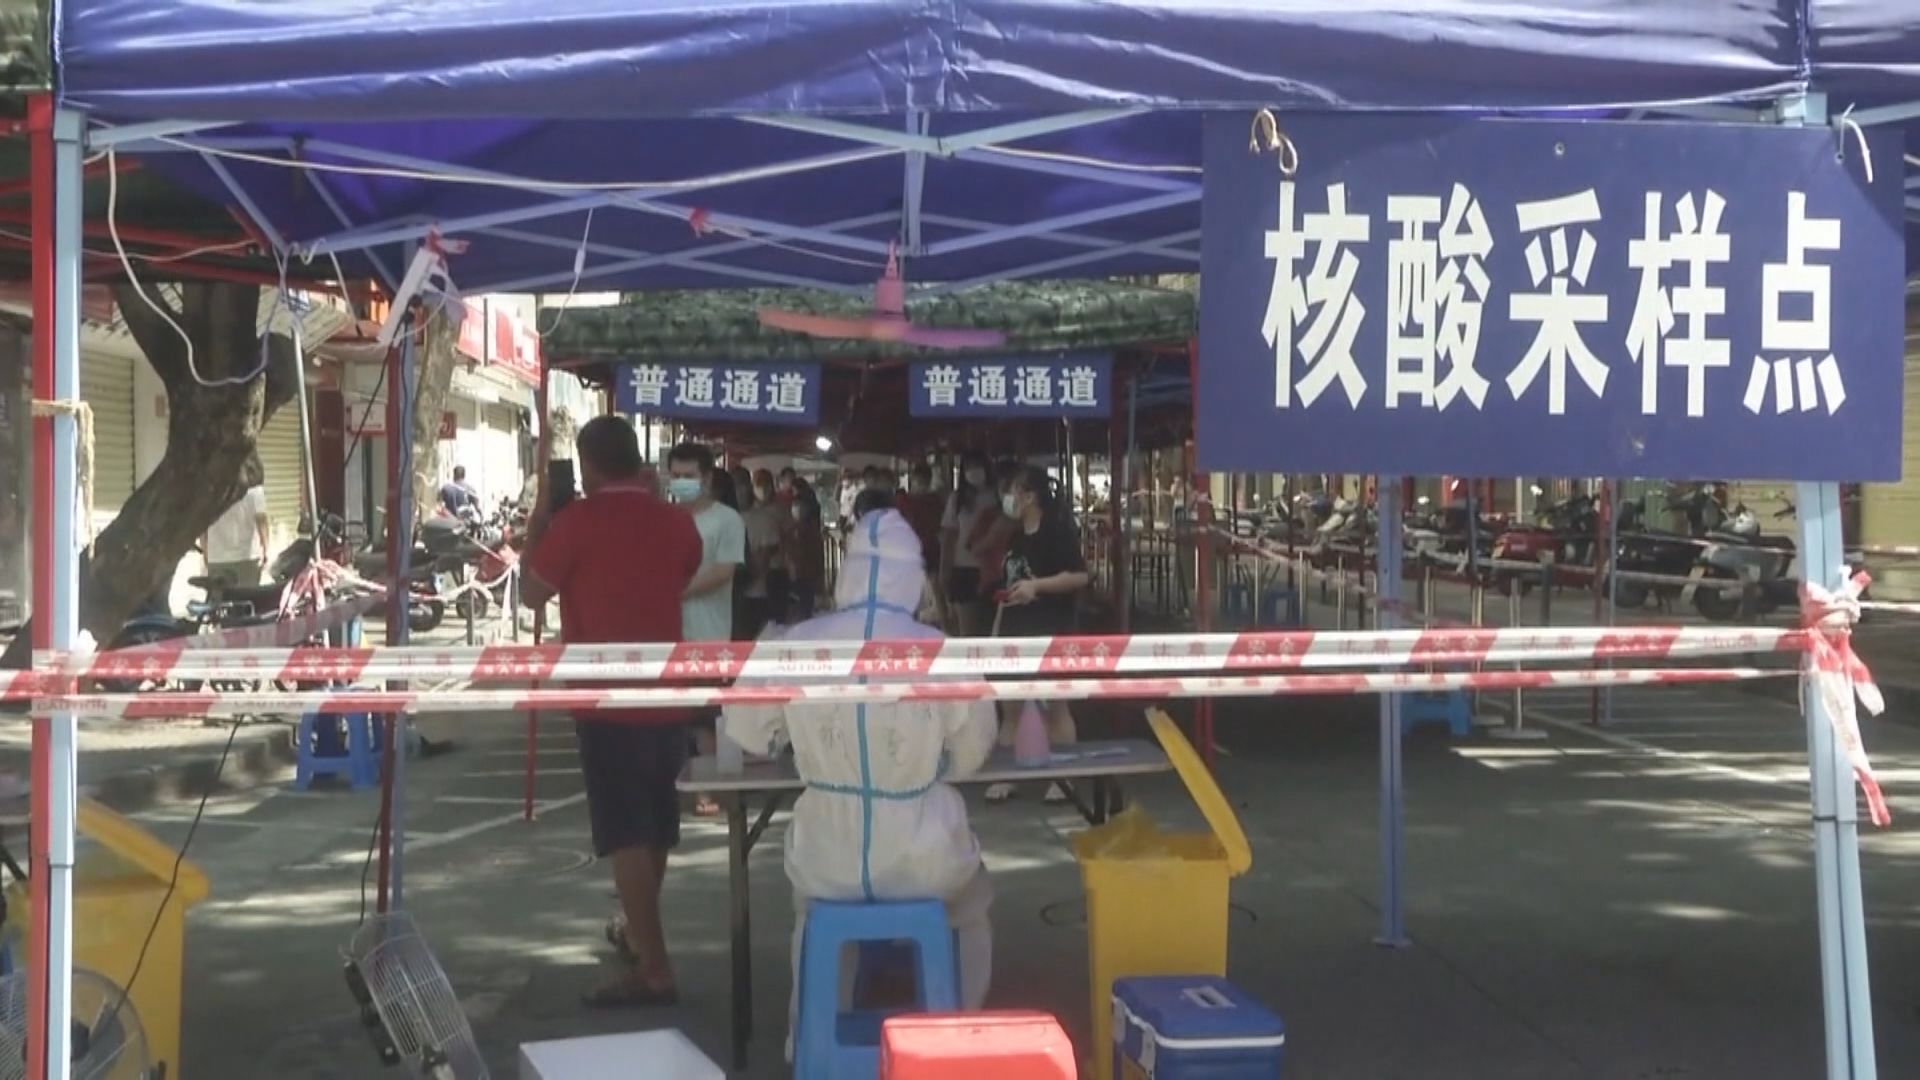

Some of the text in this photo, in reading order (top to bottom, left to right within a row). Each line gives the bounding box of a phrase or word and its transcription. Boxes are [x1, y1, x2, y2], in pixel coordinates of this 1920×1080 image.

[1261, 181, 1847, 417] 核酸采样点
[630, 364, 806, 414] 普通通道
[922, 365, 1098, 407] 普通通道
